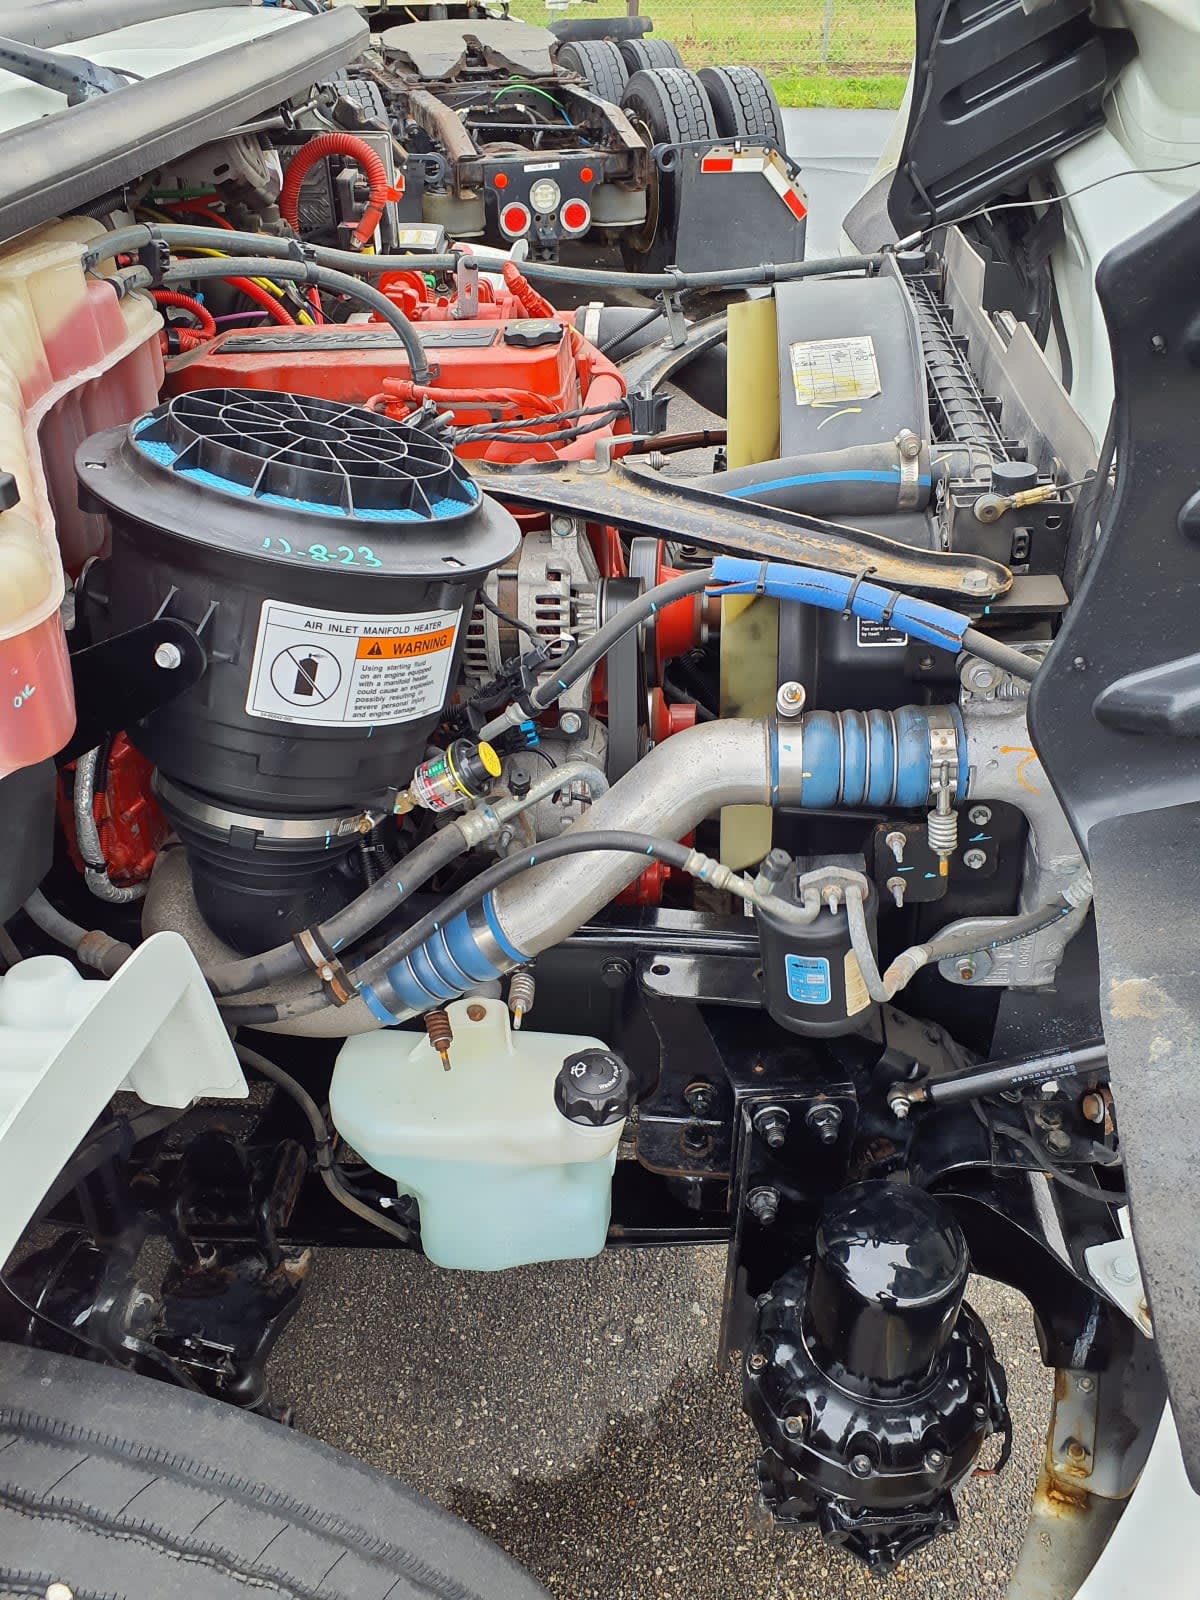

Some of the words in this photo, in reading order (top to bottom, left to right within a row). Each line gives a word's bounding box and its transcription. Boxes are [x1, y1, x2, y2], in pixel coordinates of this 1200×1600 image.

[304, 620, 323, 630] AIR
[328, 623, 358, 634] INLET
[363, 625, 410, 635] MANIFOLD
[414, 621, 442, 633] HEATER
[392, 634, 448, 655] WARNING
[361, 664, 383, 673] Using
[387, 663, 412, 671] starting
[384, 671, 405, 679] engine
[407, 665, 432, 677] equipped
[383, 678, 410, 686] manifold
[355, 695, 385, 704] possibly
[389, 692, 416, 701] resulting
[381, 700, 409, 710] personal
[411, 697, 426, 705] injury
[369, 711, 391, 719] engine
